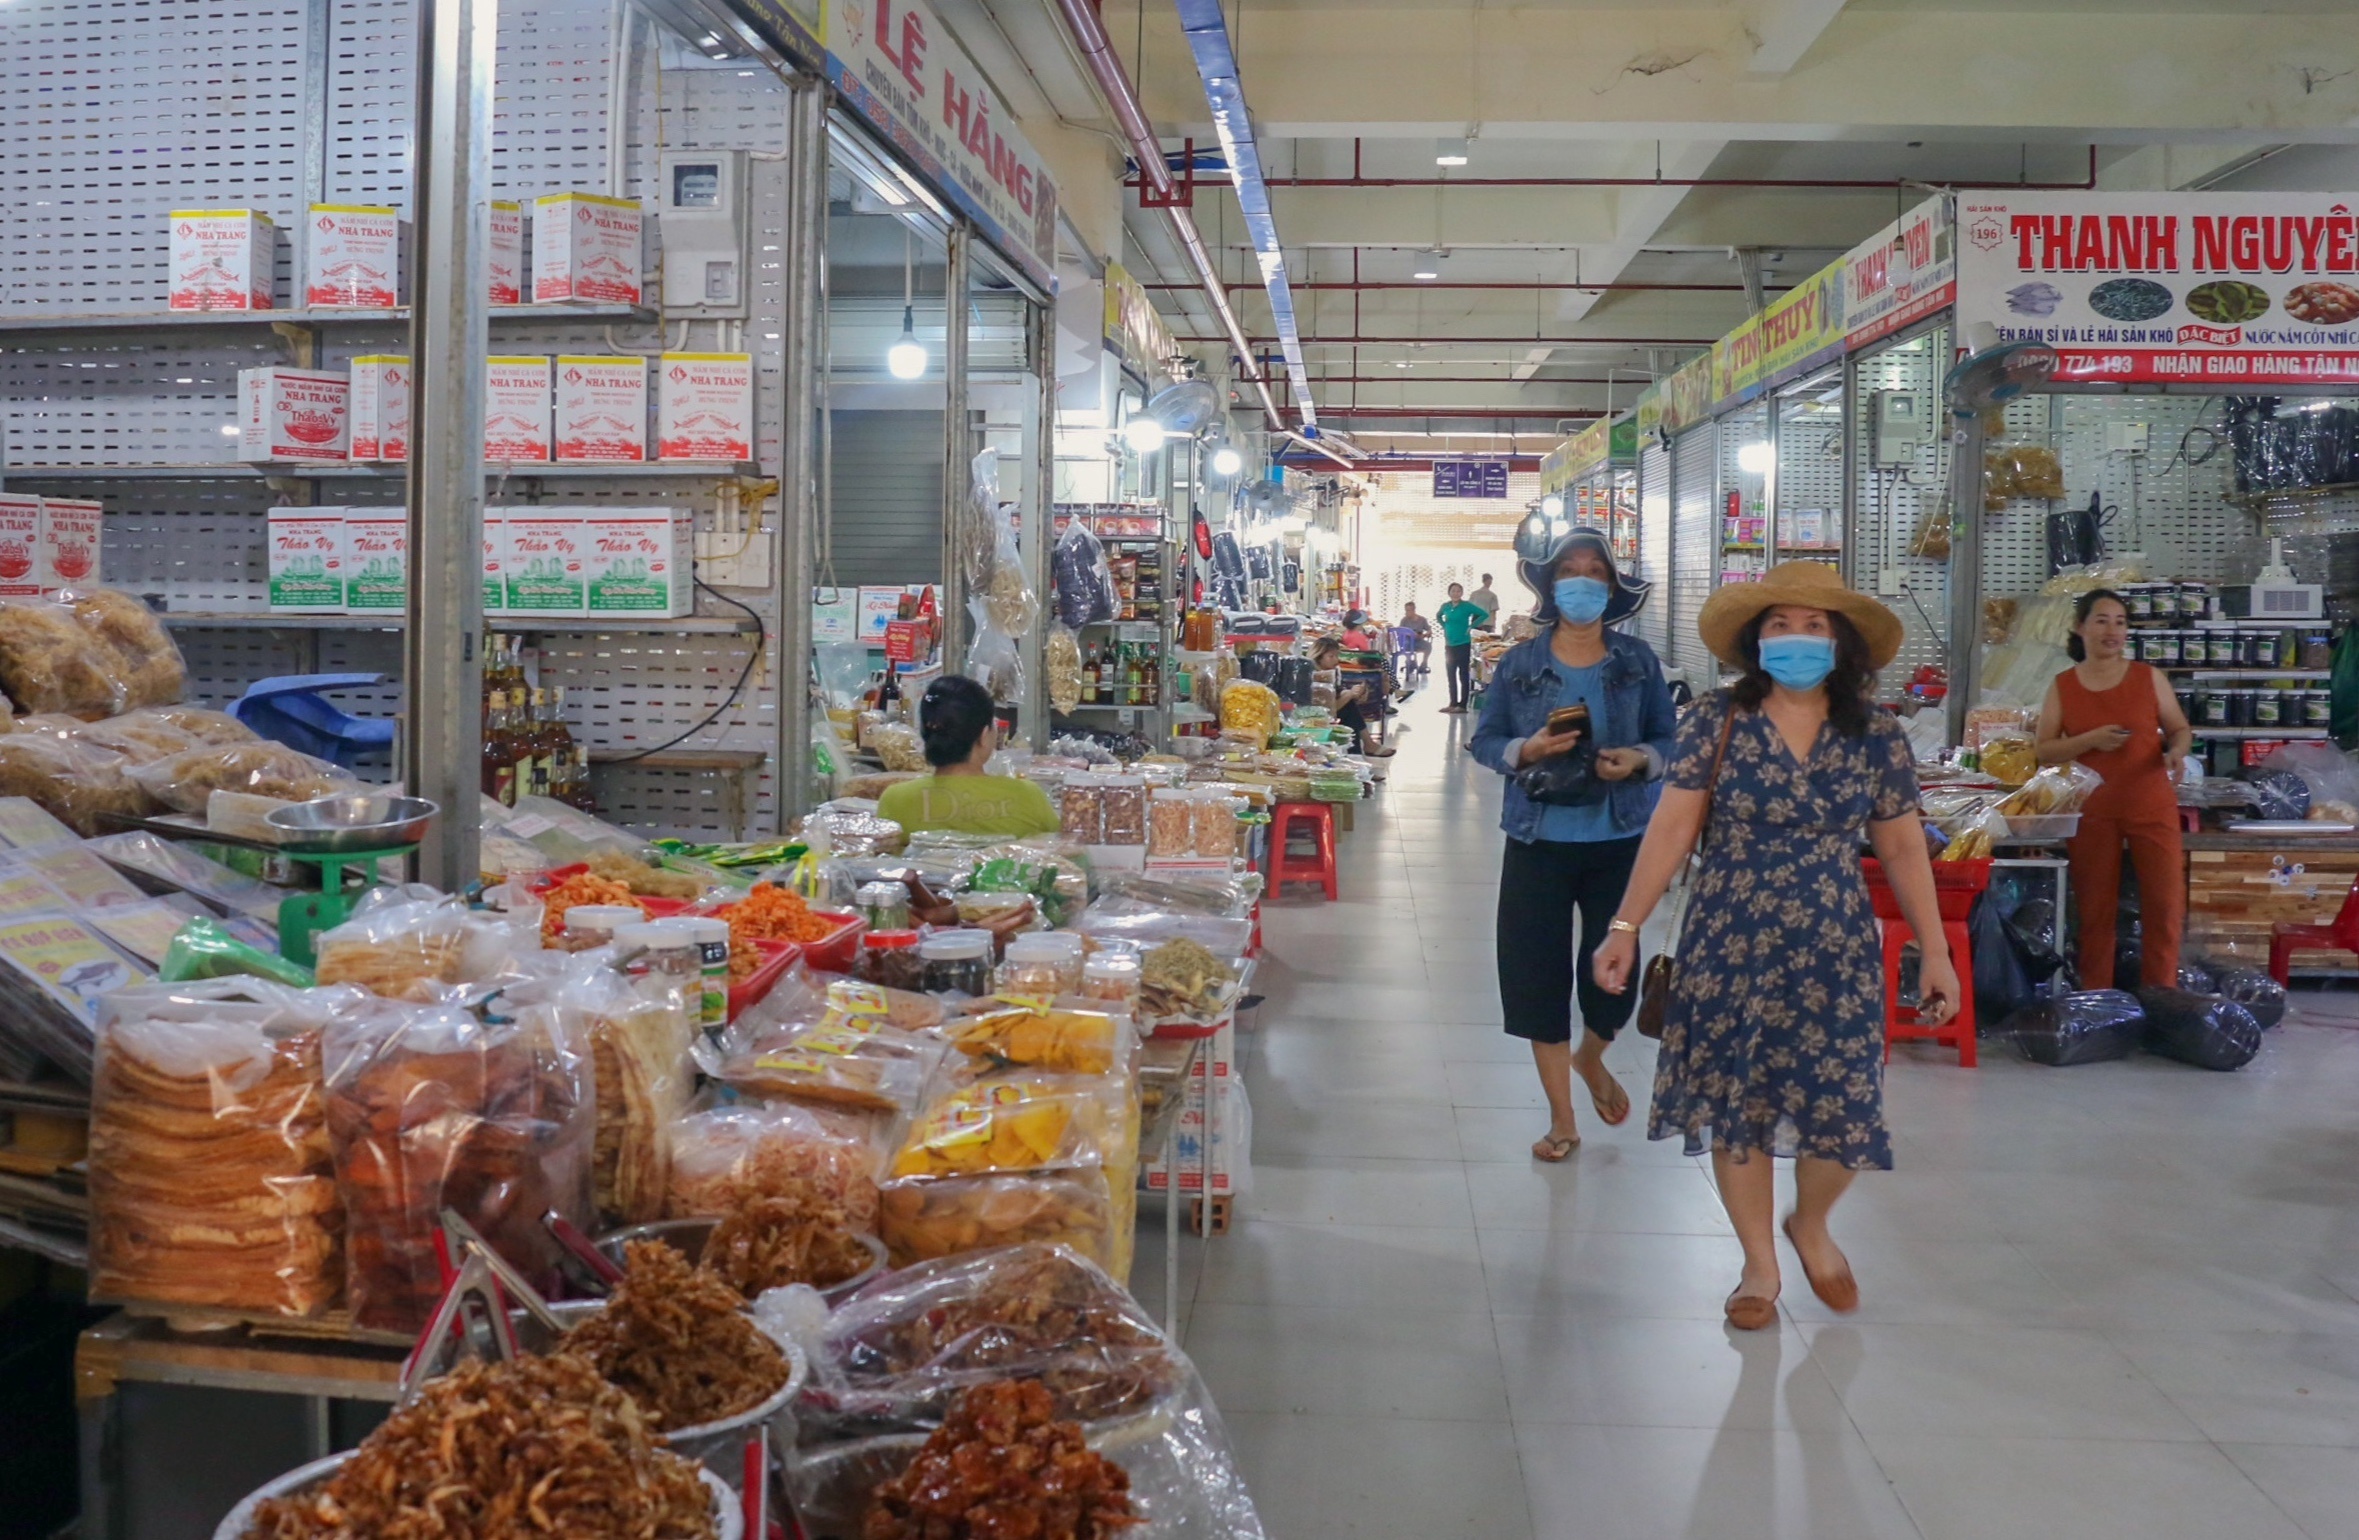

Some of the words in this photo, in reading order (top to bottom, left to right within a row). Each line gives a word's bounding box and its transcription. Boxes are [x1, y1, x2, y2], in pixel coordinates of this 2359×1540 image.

[338, 226, 359, 237] NHA
[361, 228, 394, 238] TRANG
[595, 217, 611, 228] NHA
[613, 222, 640, 233] TRANG
[196, 231, 214, 240] NHA
[217, 231, 247, 240] TRANG
[1977, 229, 1997, 240] 196
[2010, 215, 2178, 273] THANH
[2193, 204, 2359, 274] NGUYÊ
[2062, 327, 2078, 342] VÀ
[2150, 327, 2173, 343] KHÔ
[2101, 355, 2132, 373] 193
[2153, 352, 2202, 377] NHẬN
[2207, 356, 2248, 374] GIAO
[2252, 353, 2301, 375] HÀNG
[2305, 354, 2340, 378] TẬN
[490, 378, 510, 388] NHA
[513, 379, 546, 388] TRANG
[585, 378, 604, 388] NHA
[609, 378, 642, 388] TRANG
[690, 376, 711, 386] NHA
[714, 377, 747, 386] TRANG
[285, 390, 306, 401] NHA
[309, 392, 341, 404] TRANG
[315, 537, 335, 551] Vy
[554, 538, 576, 553] Vy
[637, 538, 658, 554] Vy
[922, 787, 1013, 822] Dior
